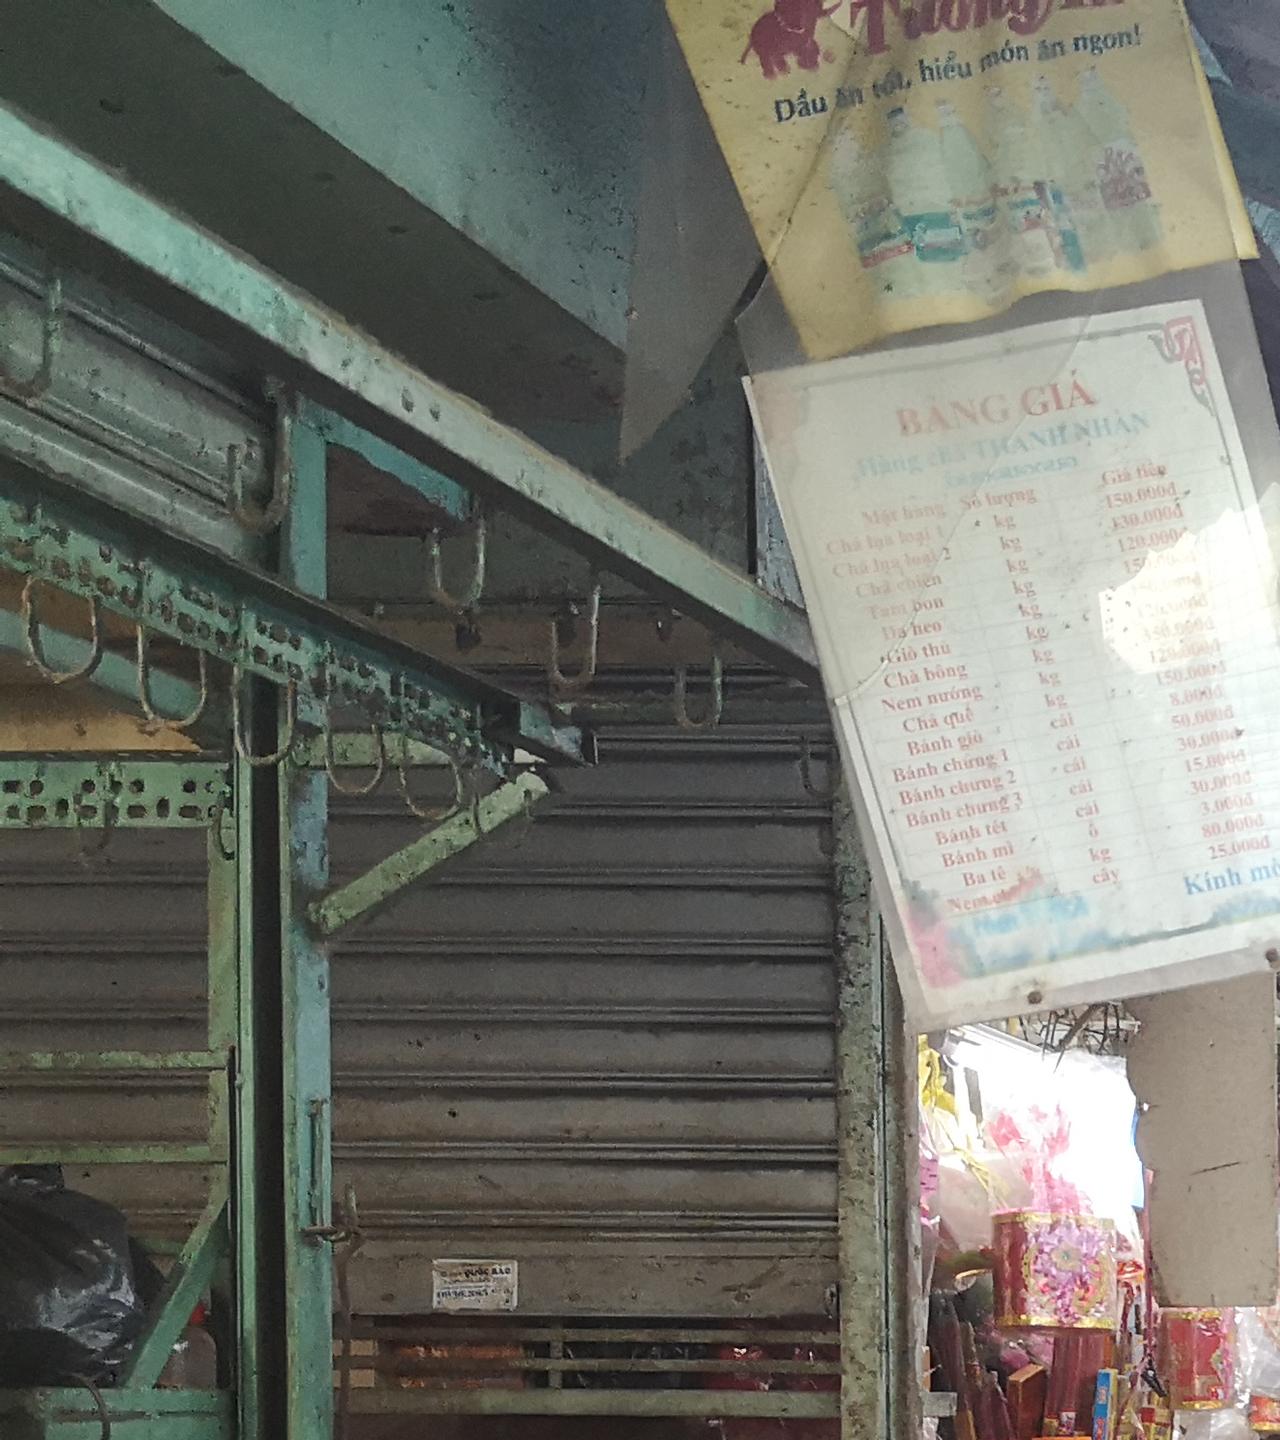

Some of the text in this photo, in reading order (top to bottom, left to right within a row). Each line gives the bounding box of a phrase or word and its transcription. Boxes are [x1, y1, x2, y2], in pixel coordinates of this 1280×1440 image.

[773, 87, 828, 123] Dầu
[918, 50, 973, 84] hiểu
[980, 39, 1029, 73] món
[1071, 22, 1142, 56] ngon!
[1021, 368, 1096, 415] GIÁ
[994, 513, 1017, 530] kg
[1000, 535, 1023, 553] kg
[1006, 557, 1030, 575] kg
[1013, 579, 1036, 598] kg
[1019, 602, 1043, 621] kg
[1026, 624, 1050, 643] kg
[1032, 648, 1055, 666] kg
[883, 662, 968, 688] Chả bông
[1039, 671, 1062, 688] kg
[883, 683, 984, 712] Nem nướng
[1045, 692, 1068, 711] kg
[903, 714, 939, 733] Chả
[908, 735, 953, 755] Bánh
[892, 761, 939, 781] Bánh
[899, 784, 945, 804] Bánh
[1006, 770, 1016, 783] 2
[906, 807, 952, 827] Bánh
[935, 825, 981, 845] Bánh
[942, 847, 988, 867] Bánh
[1089, 846, 1112, 864] kg
[963, 870, 986, 886] Ba
[1184, 866, 1242, 895] Kính
